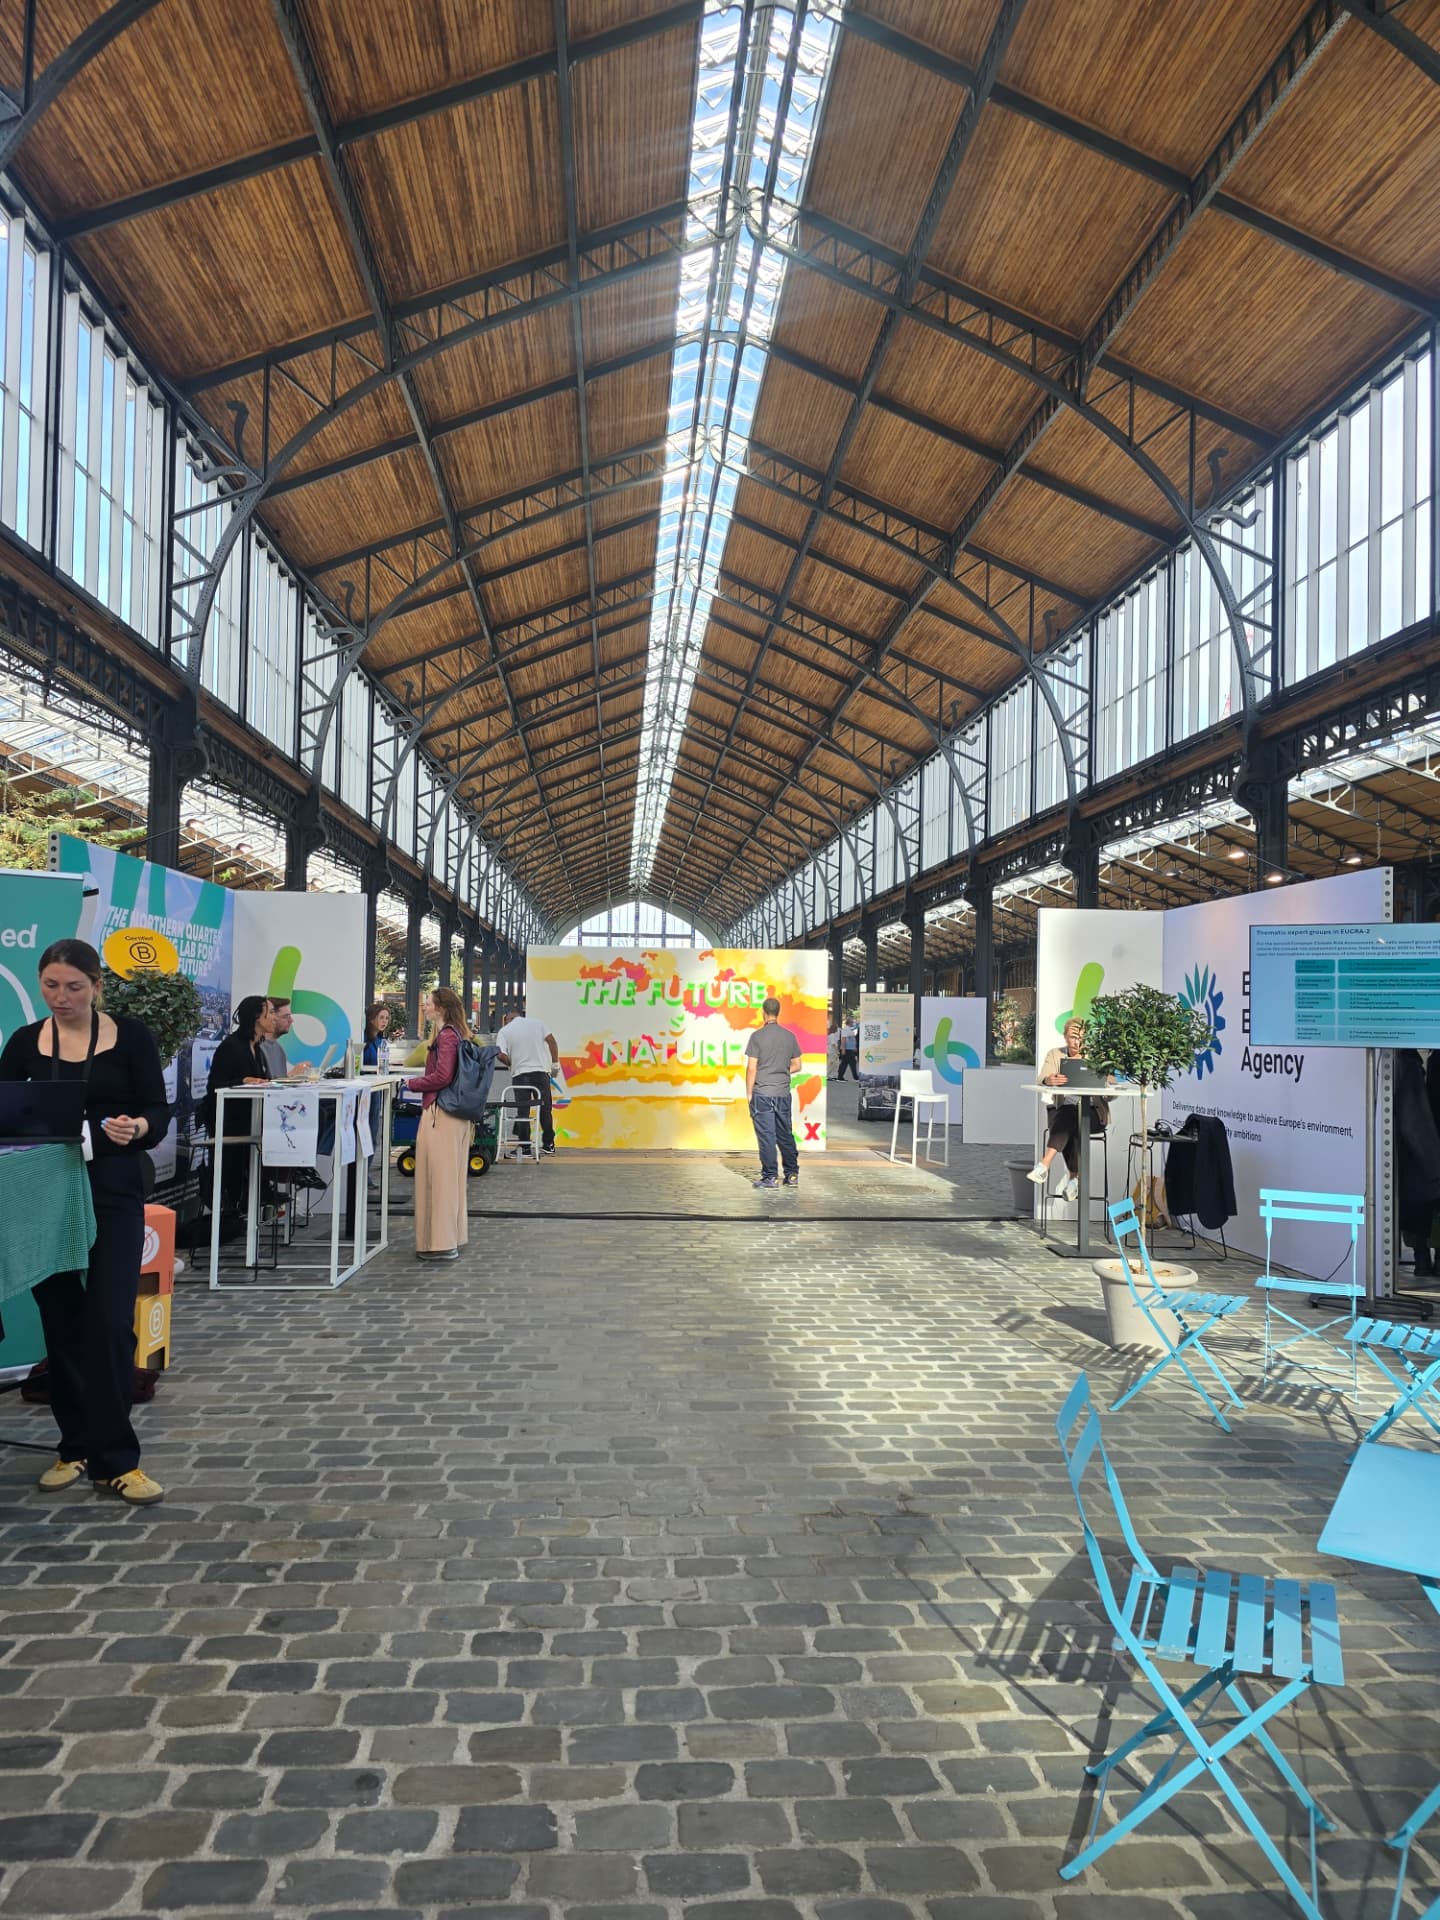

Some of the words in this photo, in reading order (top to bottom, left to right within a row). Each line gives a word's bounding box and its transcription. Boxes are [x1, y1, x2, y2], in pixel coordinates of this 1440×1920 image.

[105, 907, 130, 927] THE
[129, 909, 185, 938] NORTHERN
[186, 923, 222, 946] QUARTER
[1288, 929, 1308, 937] expert
[1309, 929, 1332, 937] groups
[137, 946, 151, 959] B
[180, 940, 196, 958] LAB
[197, 943, 213, 961] FOR
[576, 979, 636, 1006] THE
[647, 979, 767, 1008] FUTURE
[602, 1039, 745, 1068] NATURE
[1241, 1046, 1304, 1083] Agency
[1172, 1100, 1195, 1113] Delivering
[1195, 1103, 1206, 1114] data
[1206, 1106, 1216, 1116] and
[1216, 1107, 1247, 1122] knowledge
[1247, 1112, 1254, 1122] to
[1254, 1113, 1278, 1126] achieve
[1278, 1116, 1306, 1130] Europe's
[1307, 1122, 1354, 1139] environment,
[1233, 1129, 1262, 1142] ambitions
